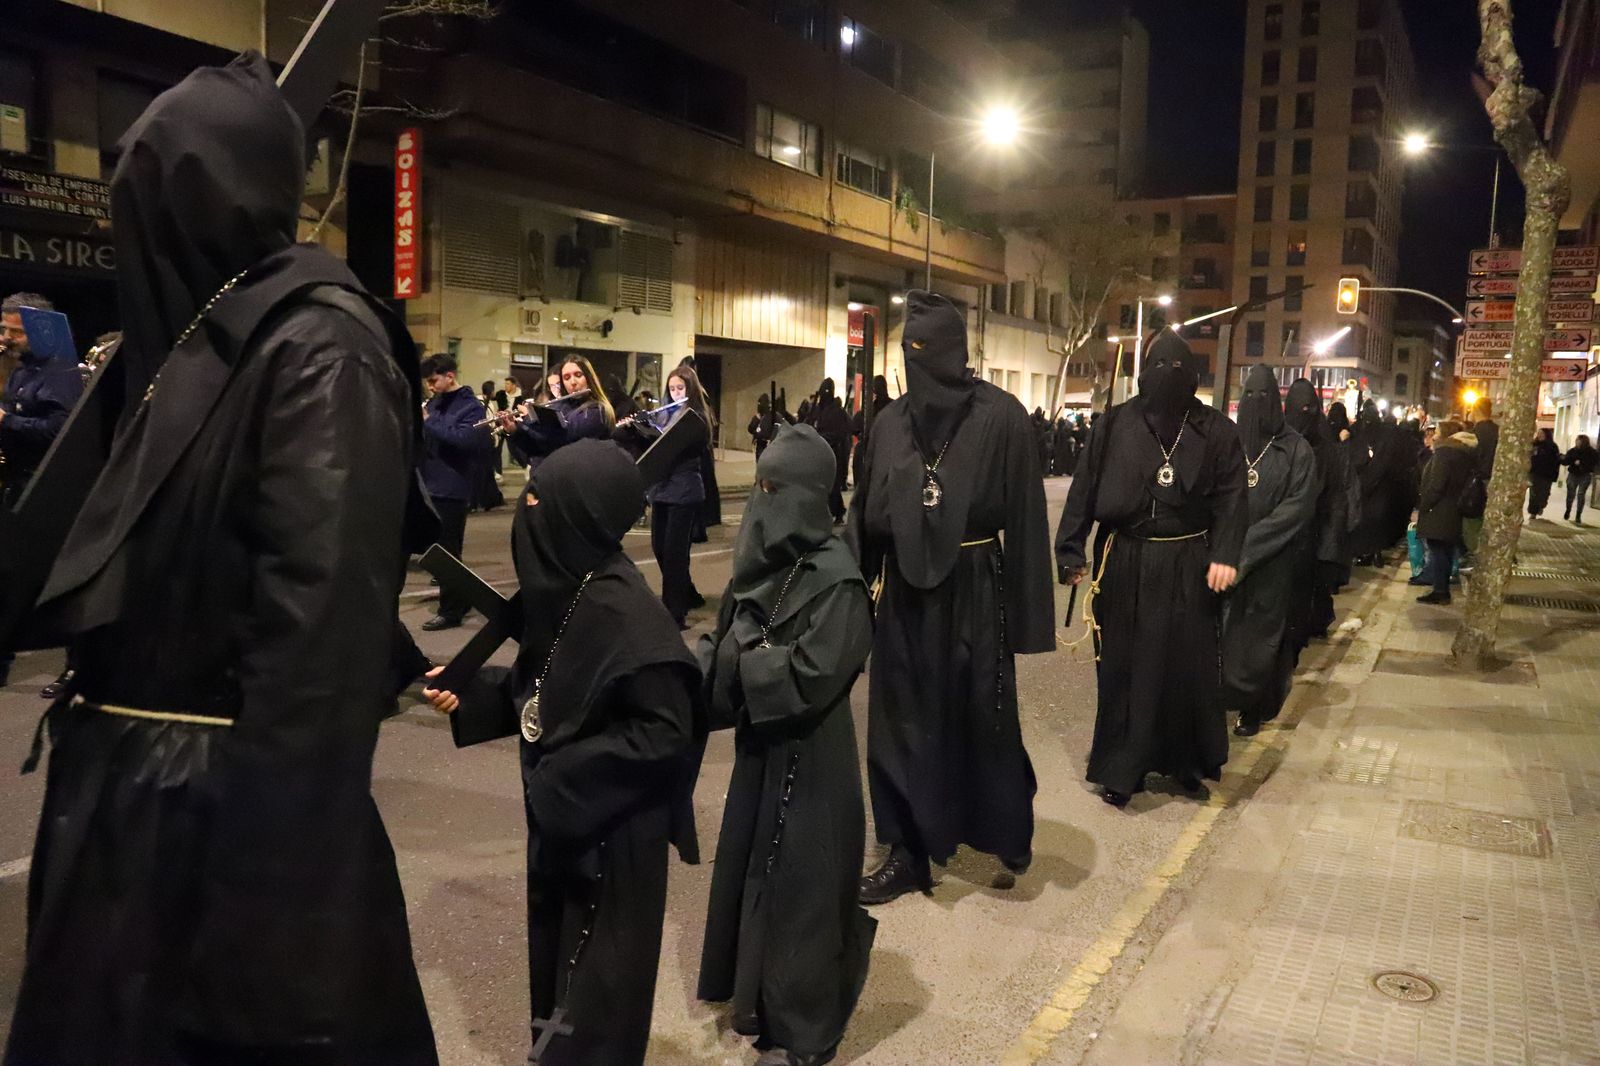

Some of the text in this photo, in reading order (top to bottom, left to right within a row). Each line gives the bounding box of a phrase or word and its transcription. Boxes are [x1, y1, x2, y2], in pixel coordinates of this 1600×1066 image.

[50, 175, 62, 189] DE
[64, 178, 111, 195] EMPRESAS
[2, 192, 27, 205] LUIS
[67, 203, 82, 215] DE
[1466, 368, 1500, 377] ORENSE
